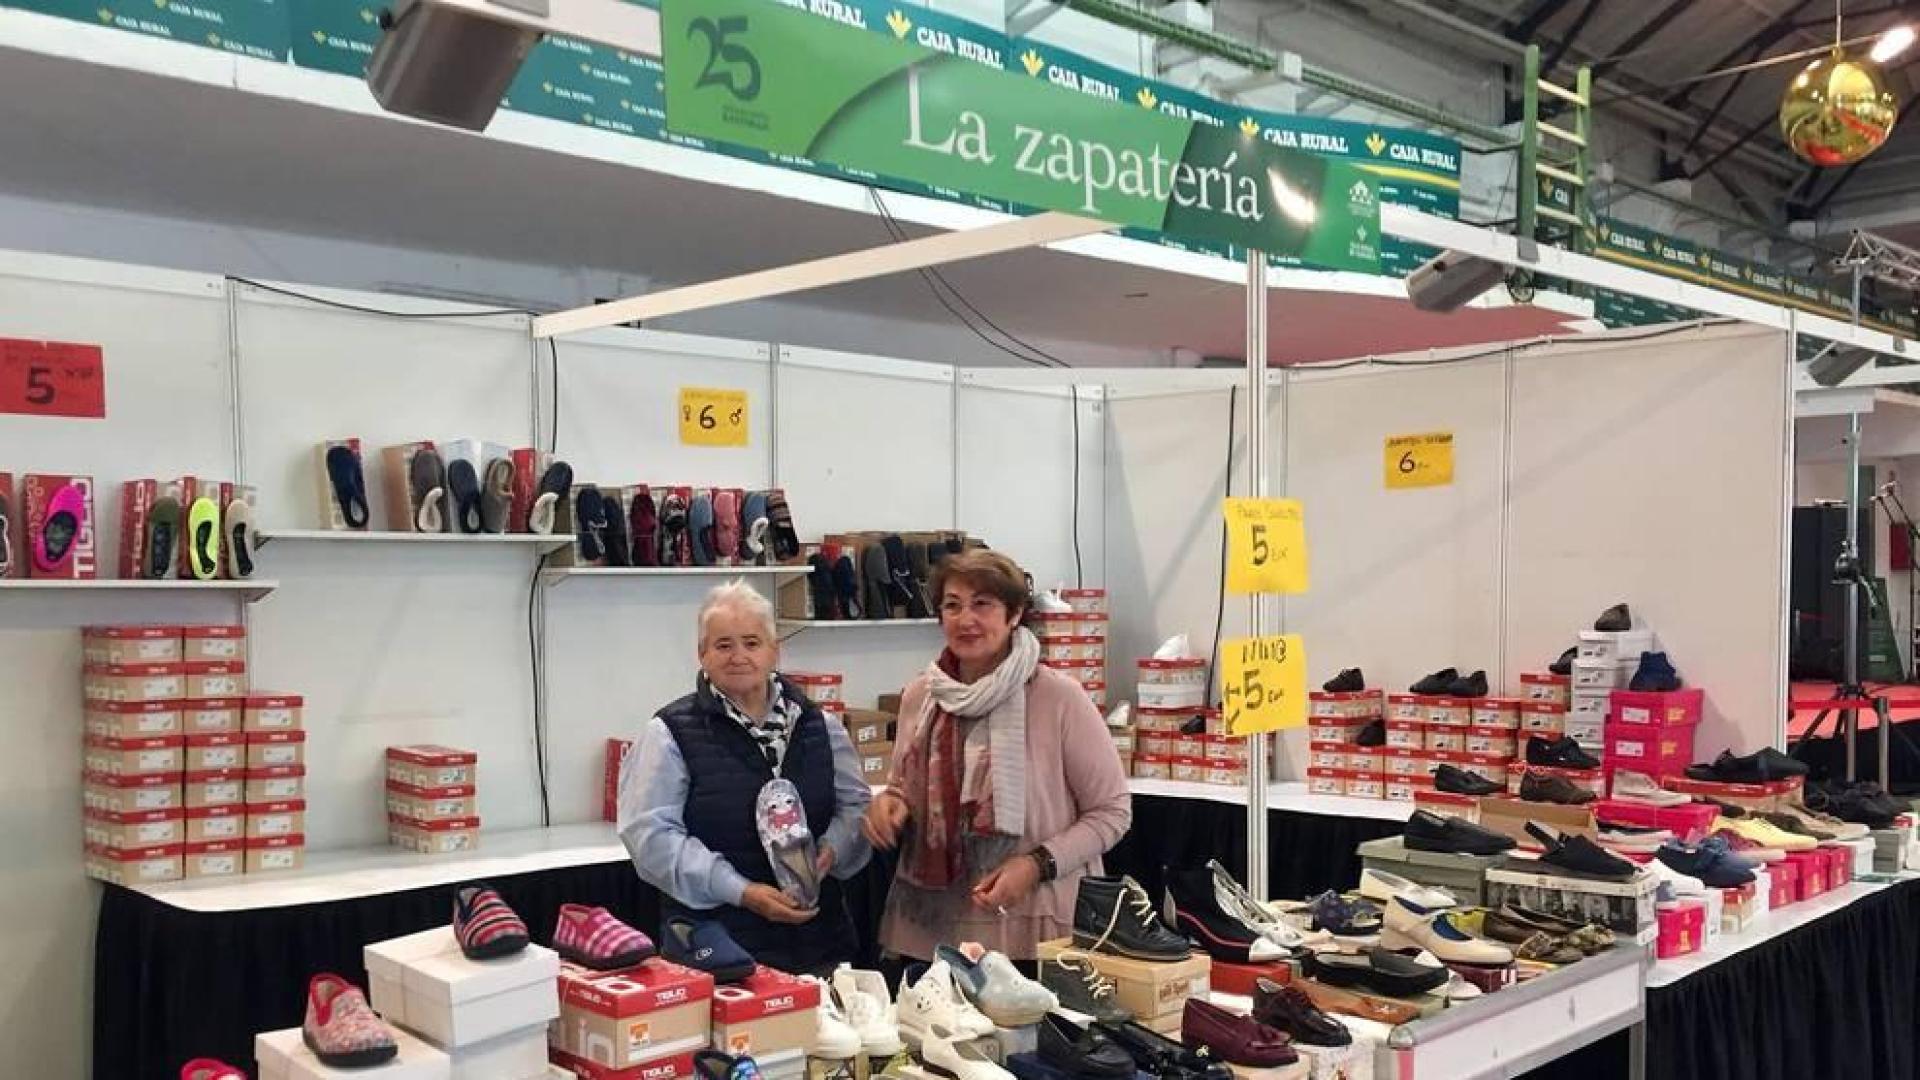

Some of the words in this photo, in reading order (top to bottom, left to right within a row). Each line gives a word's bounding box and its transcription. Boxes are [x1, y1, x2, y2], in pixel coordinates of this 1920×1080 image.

[686, 14, 761, 101] 25
[916, 26, 955, 54] CAJA
[957, 37, 1005, 70] RURAL
[903, 66, 996, 164] La
[1014, 124, 1265, 222] zapatería
[1300, 133, 1349, 154] RURAL
[1389, 143, 1420, 162] CAJA
[1420, 149, 1458, 172] RURAL
[25, 366, 55, 404] 5
[699, 404, 716, 429] 6
[1399, 450, 1415, 474] 6
[1251, 524, 1269, 566] 5
[1243, 668, 1264, 710] 5
